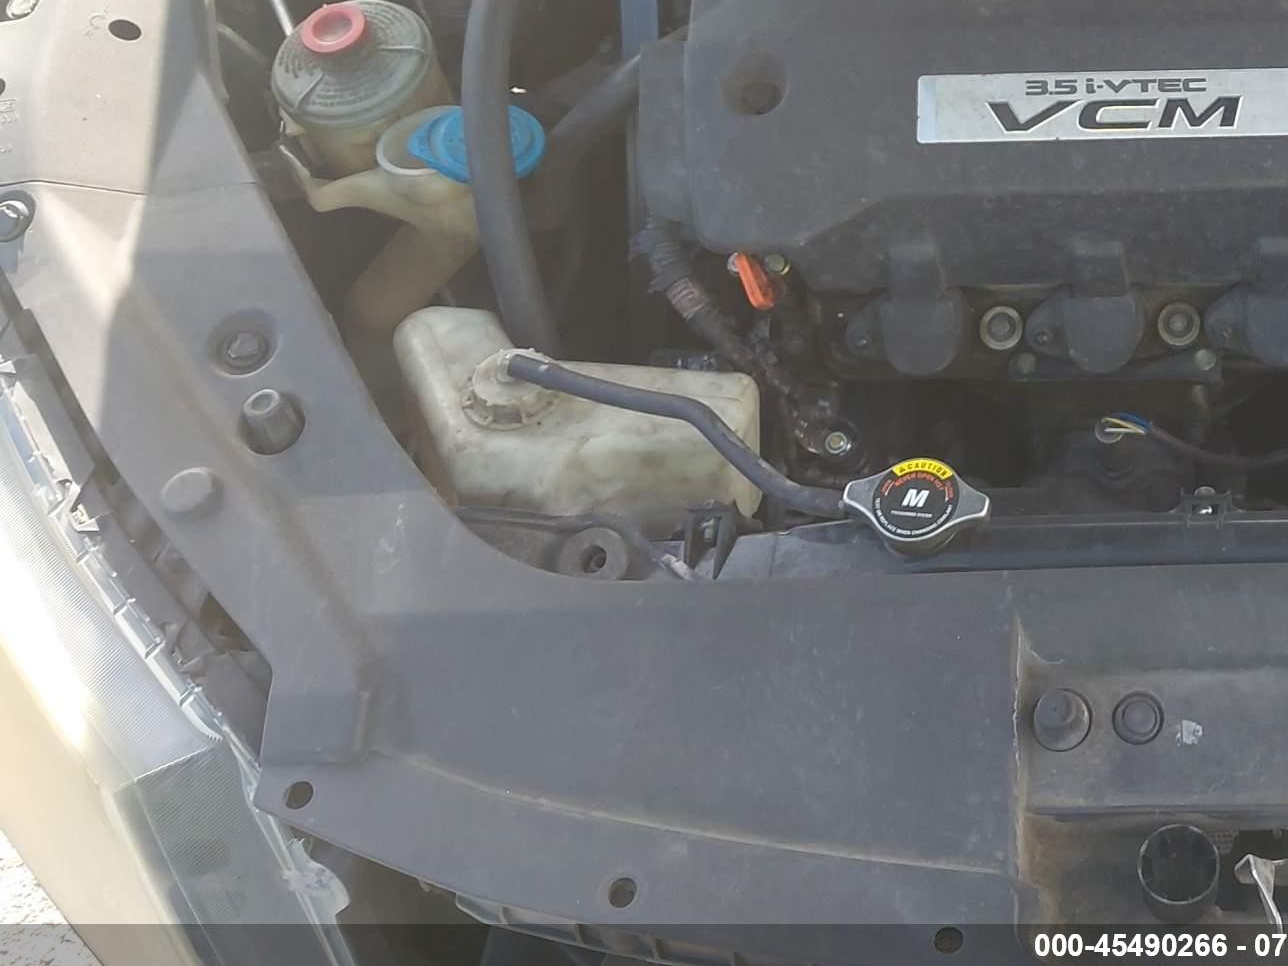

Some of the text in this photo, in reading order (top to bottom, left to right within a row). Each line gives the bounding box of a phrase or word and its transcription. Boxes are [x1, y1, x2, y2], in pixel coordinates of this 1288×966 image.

[1025, 77, 1207, 96] 3.5 i-VTEC
[985, 96, 1244, 133] VCM
[907, 462, 948, 477] CAUTION
[901, 489, 930, 507] M
